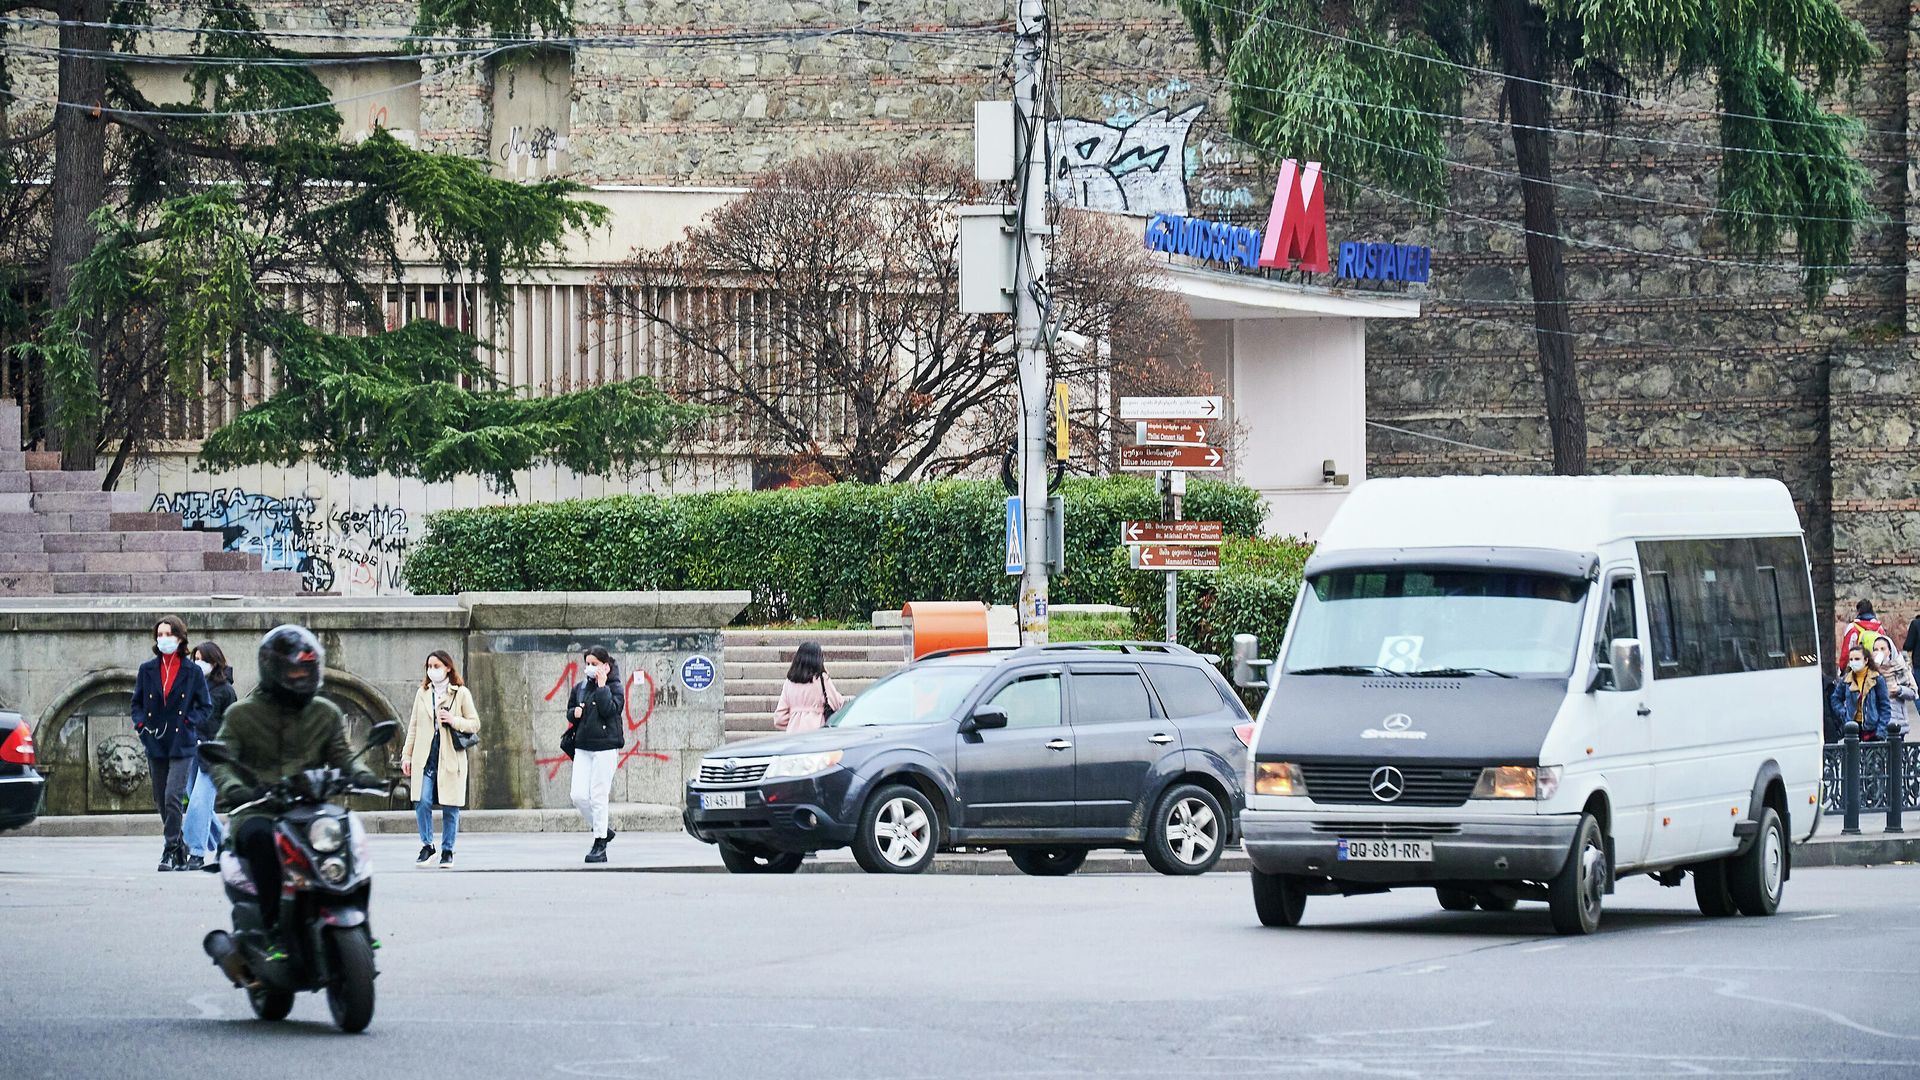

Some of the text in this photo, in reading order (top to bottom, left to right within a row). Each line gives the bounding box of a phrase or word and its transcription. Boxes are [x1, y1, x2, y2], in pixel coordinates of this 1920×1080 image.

[1338, 240, 1431, 283] RUSTAVELI
[1140, 459, 1174, 467] Monastery
[1349, 841, 1421, 858] QQ-881-RR
